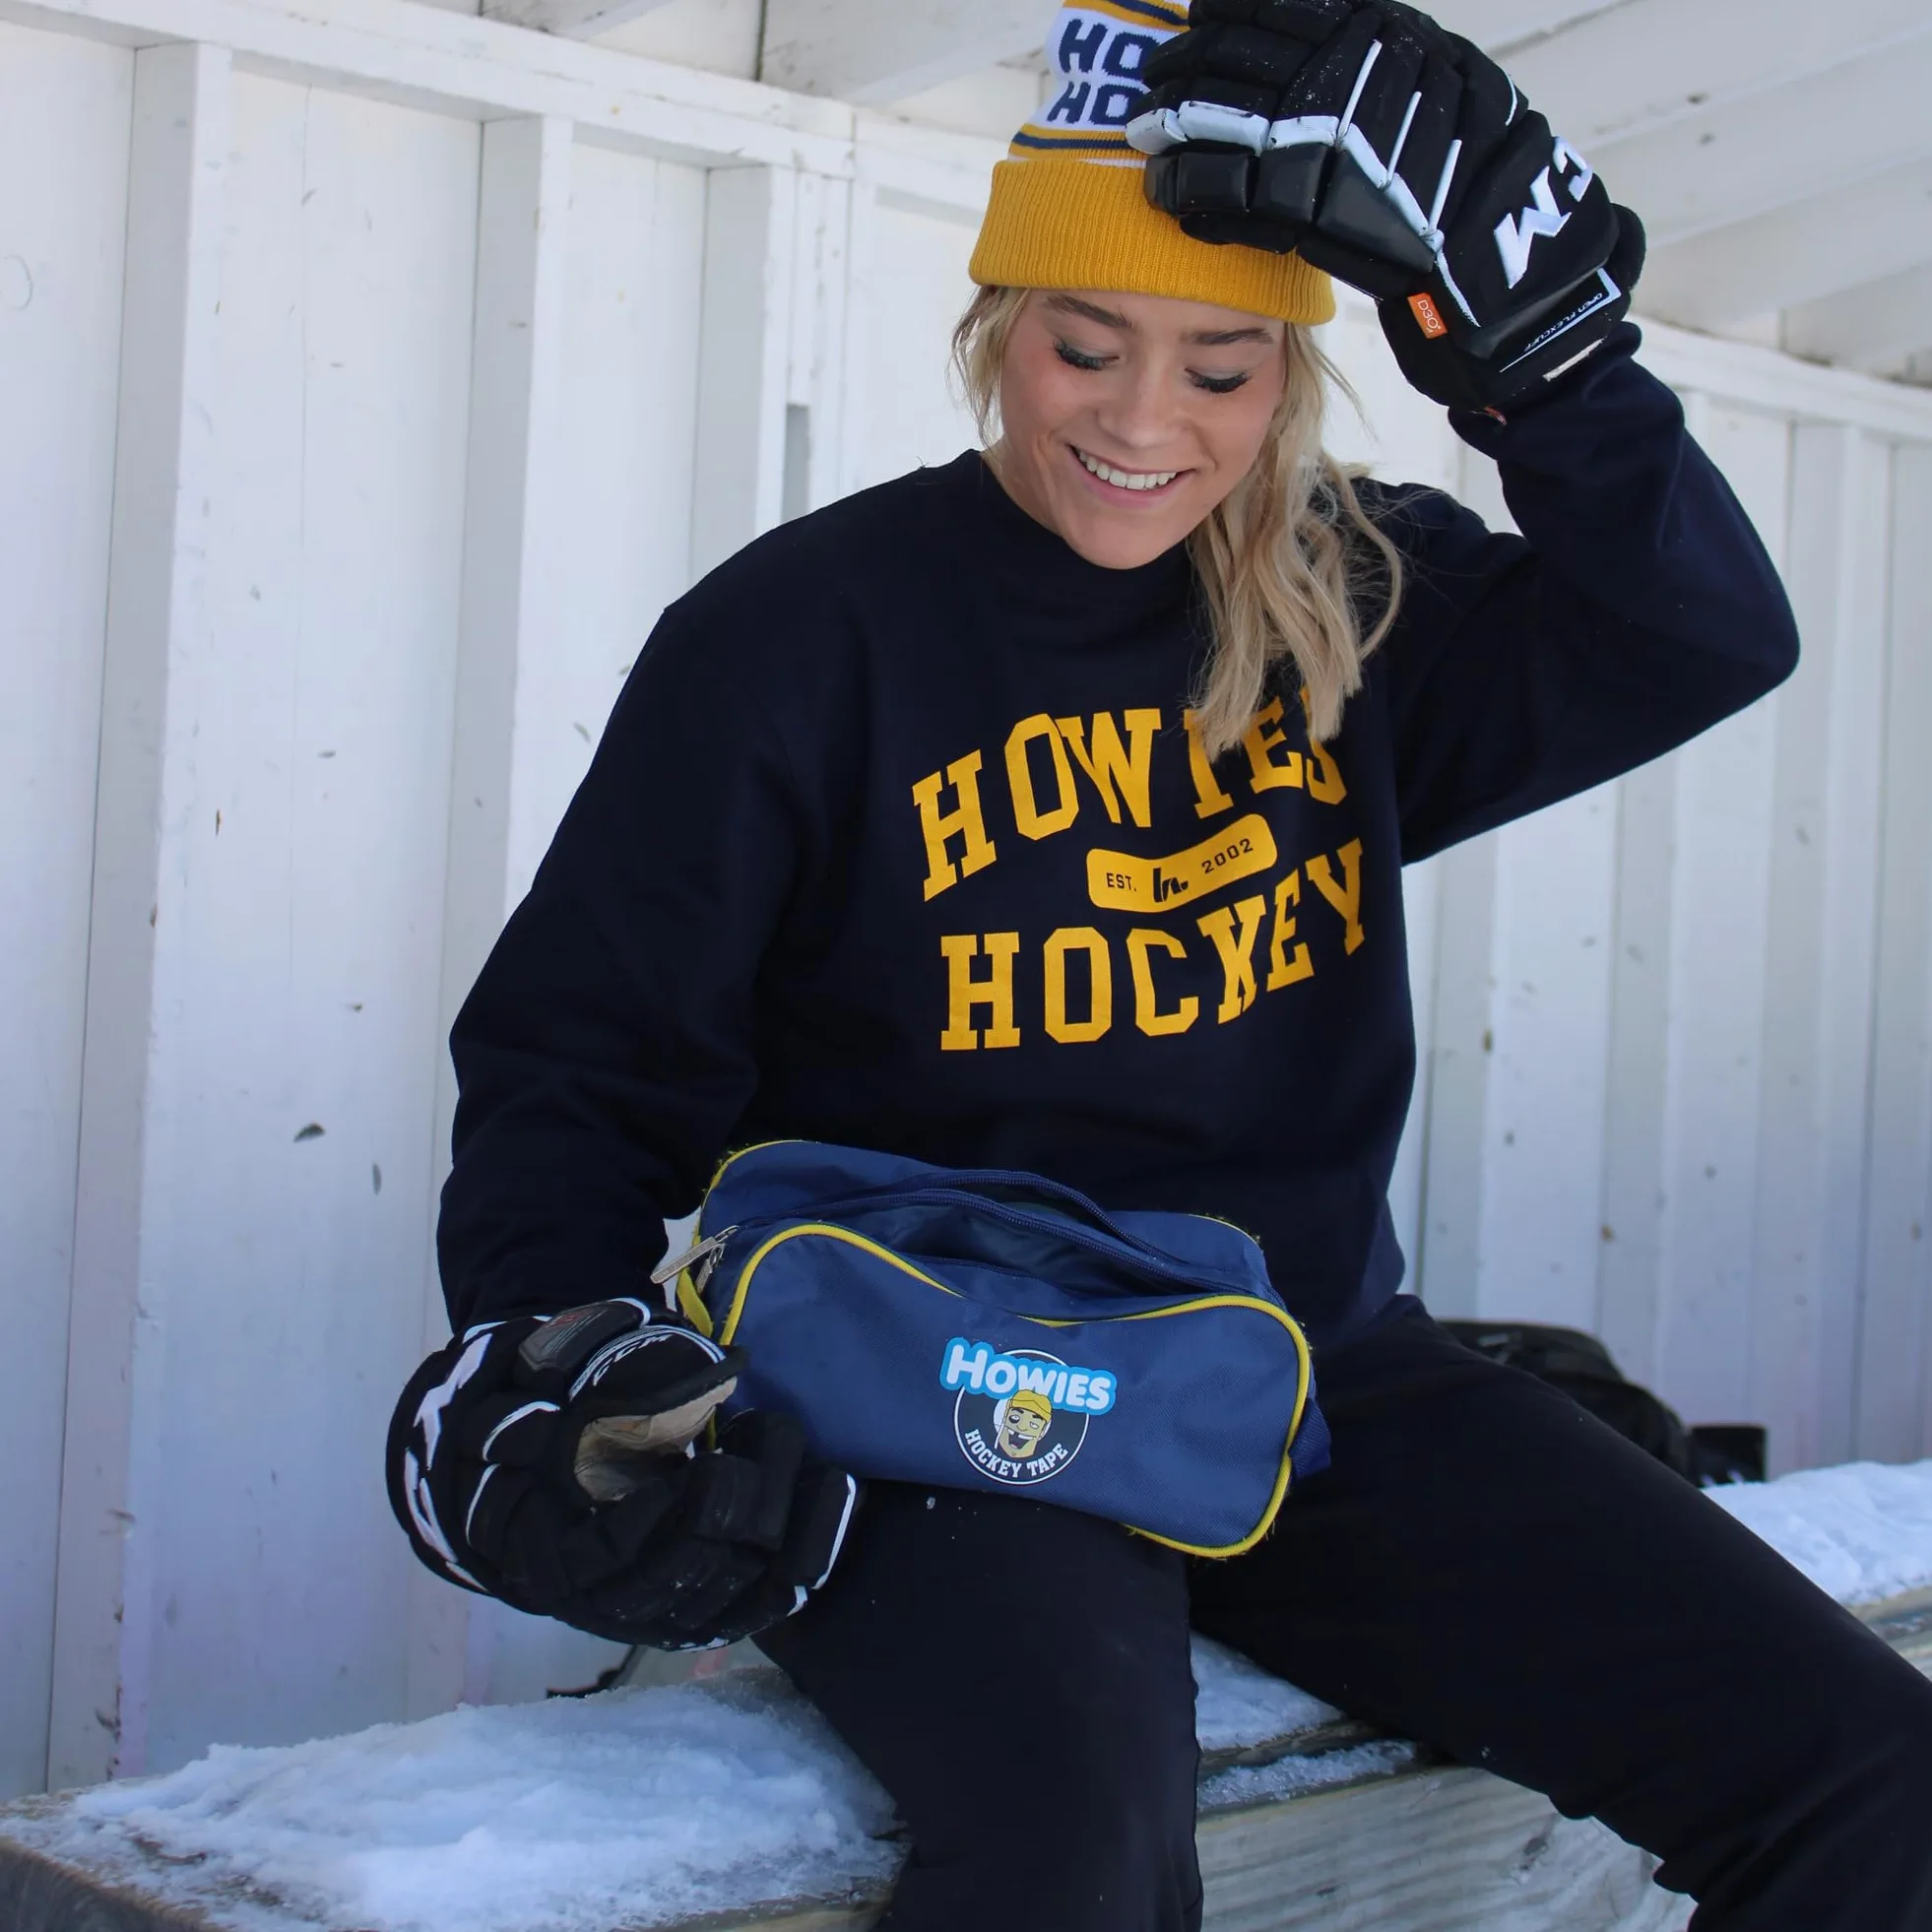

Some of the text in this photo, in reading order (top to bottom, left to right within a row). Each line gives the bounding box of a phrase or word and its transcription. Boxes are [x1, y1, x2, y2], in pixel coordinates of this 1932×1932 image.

[1493, 136, 1593, 289] CM
[1578, 292, 1603, 313] OPEN
[1106, 871, 1137, 892] EST.
[1201, 838, 1254, 874] 2002
[940, 838, 1366, 1051] HOCKEY
[945, 1343, 1112, 1410] HOWIES
[965, 1429, 1068, 1478] HOCKEY TAPE
